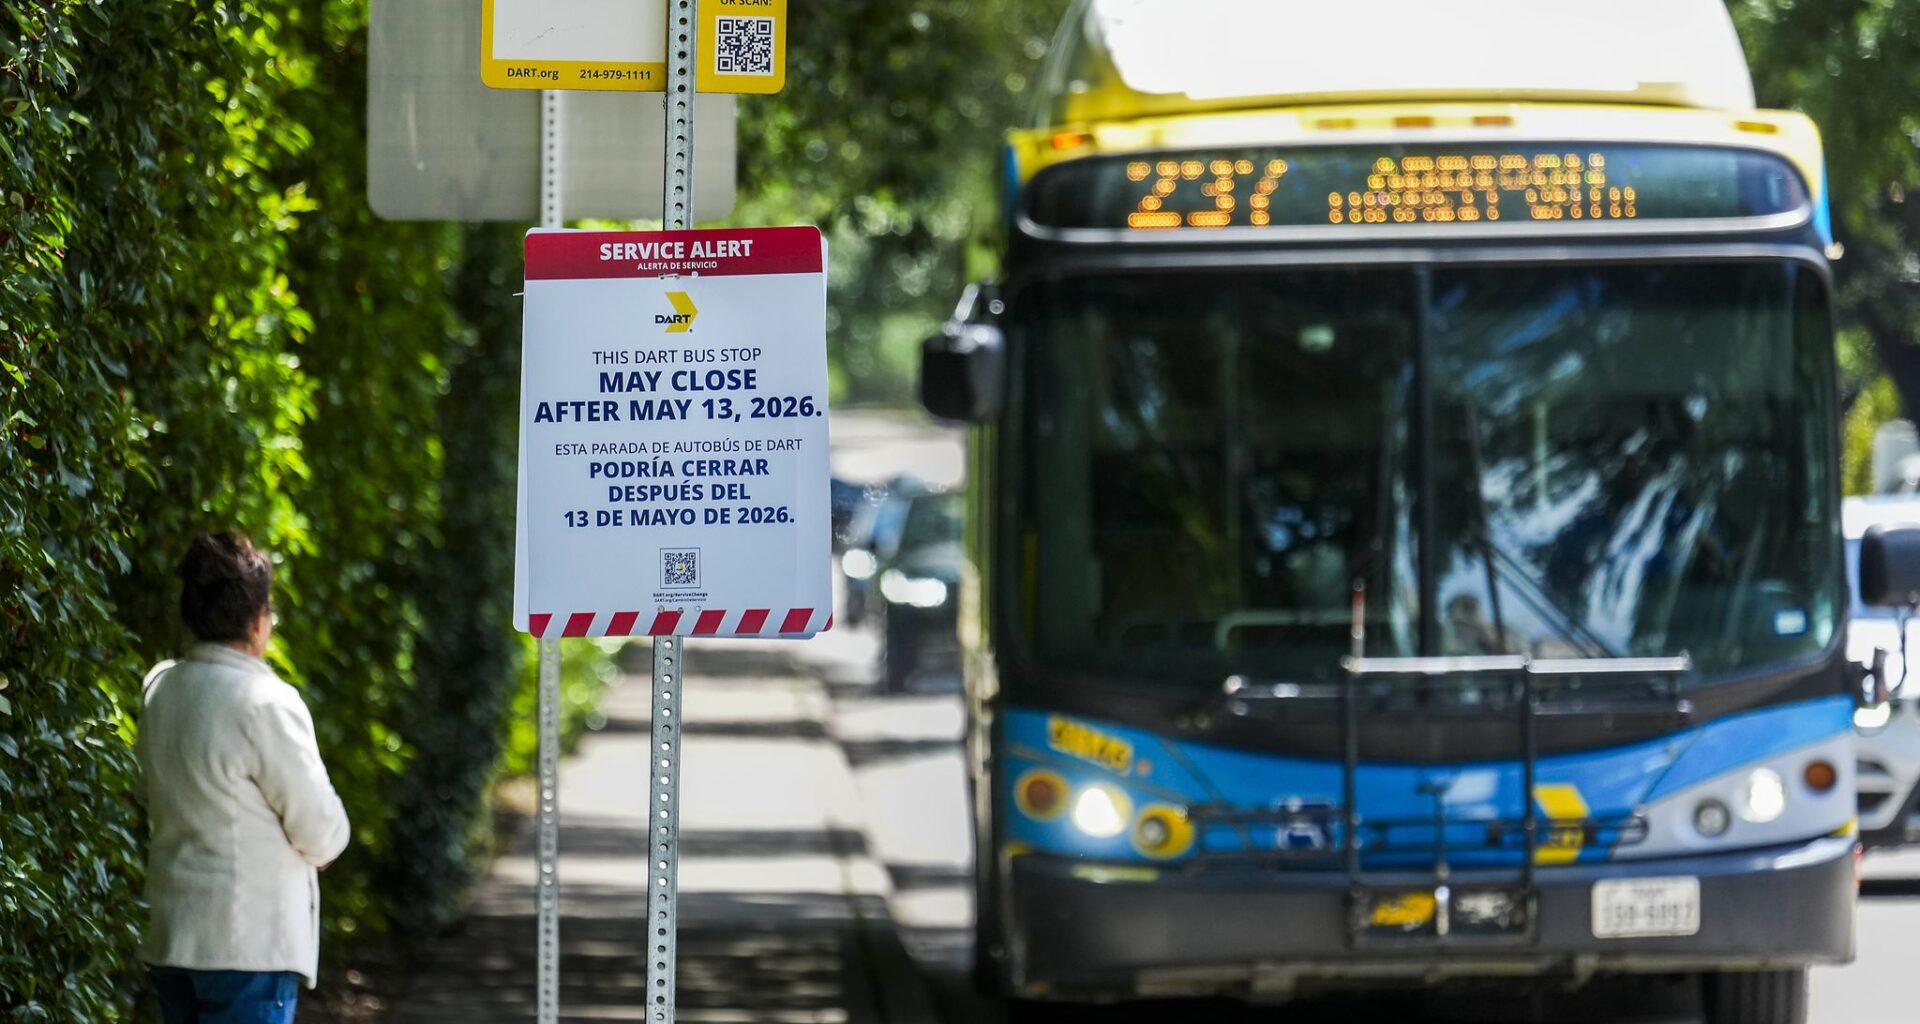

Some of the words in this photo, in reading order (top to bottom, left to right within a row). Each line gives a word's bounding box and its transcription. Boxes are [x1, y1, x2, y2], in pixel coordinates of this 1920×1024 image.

[507, 68, 559, 80] DART.org
[580, 69, 651, 80] 214-979-1111
[1126, 158, 1288, 228] 237
[600, 242, 684, 260] SERVICE
[690, 240, 753, 258] ALERT
[637, 262, 668, 271] ALERTA
[670, 262, 681, 270] DE
[683, 261, 718, 270] SERVICIO
[655, 314, 691, 324] DART
[593, 351, 629, 365] THIS
[635, 350, 678, 364] DART
[684, 349, 716, 363] BUS
[721, 348, 762, 362] STOP
[600, 371, 662, 393] MAY
[672, 369, 757, 391] CLOSE
[534, 401, 620, 423] AFTER
[630, 399, 692, 421] MAY
[702, 398, 741, 423] 13,
[751, 396, 822, 418] 2026.
[556, 443, 587, 455] ESTA
[592, 442, 648, 455] PARADA
[653, 441, 670, 454] DE
[674, 438, 740, 453] AUTOBÚS
[745, 440, 762, 452] DE
[767, 439, 803, 452] DART
[590, 456, 675, 479] PODRÍA
[682, 459, 770, 477] CERRAR
[609, 480, 703, 502] DESPUÉS
[712, 484, 751, 501] DEL
[565, 511, 589, 528] 13
[597, 510, 623, 527] DE
[631, 509, 696, 526] MAYO
[704, 508, 731, 525] DE
[738, 506, 795, 524] 2026.
